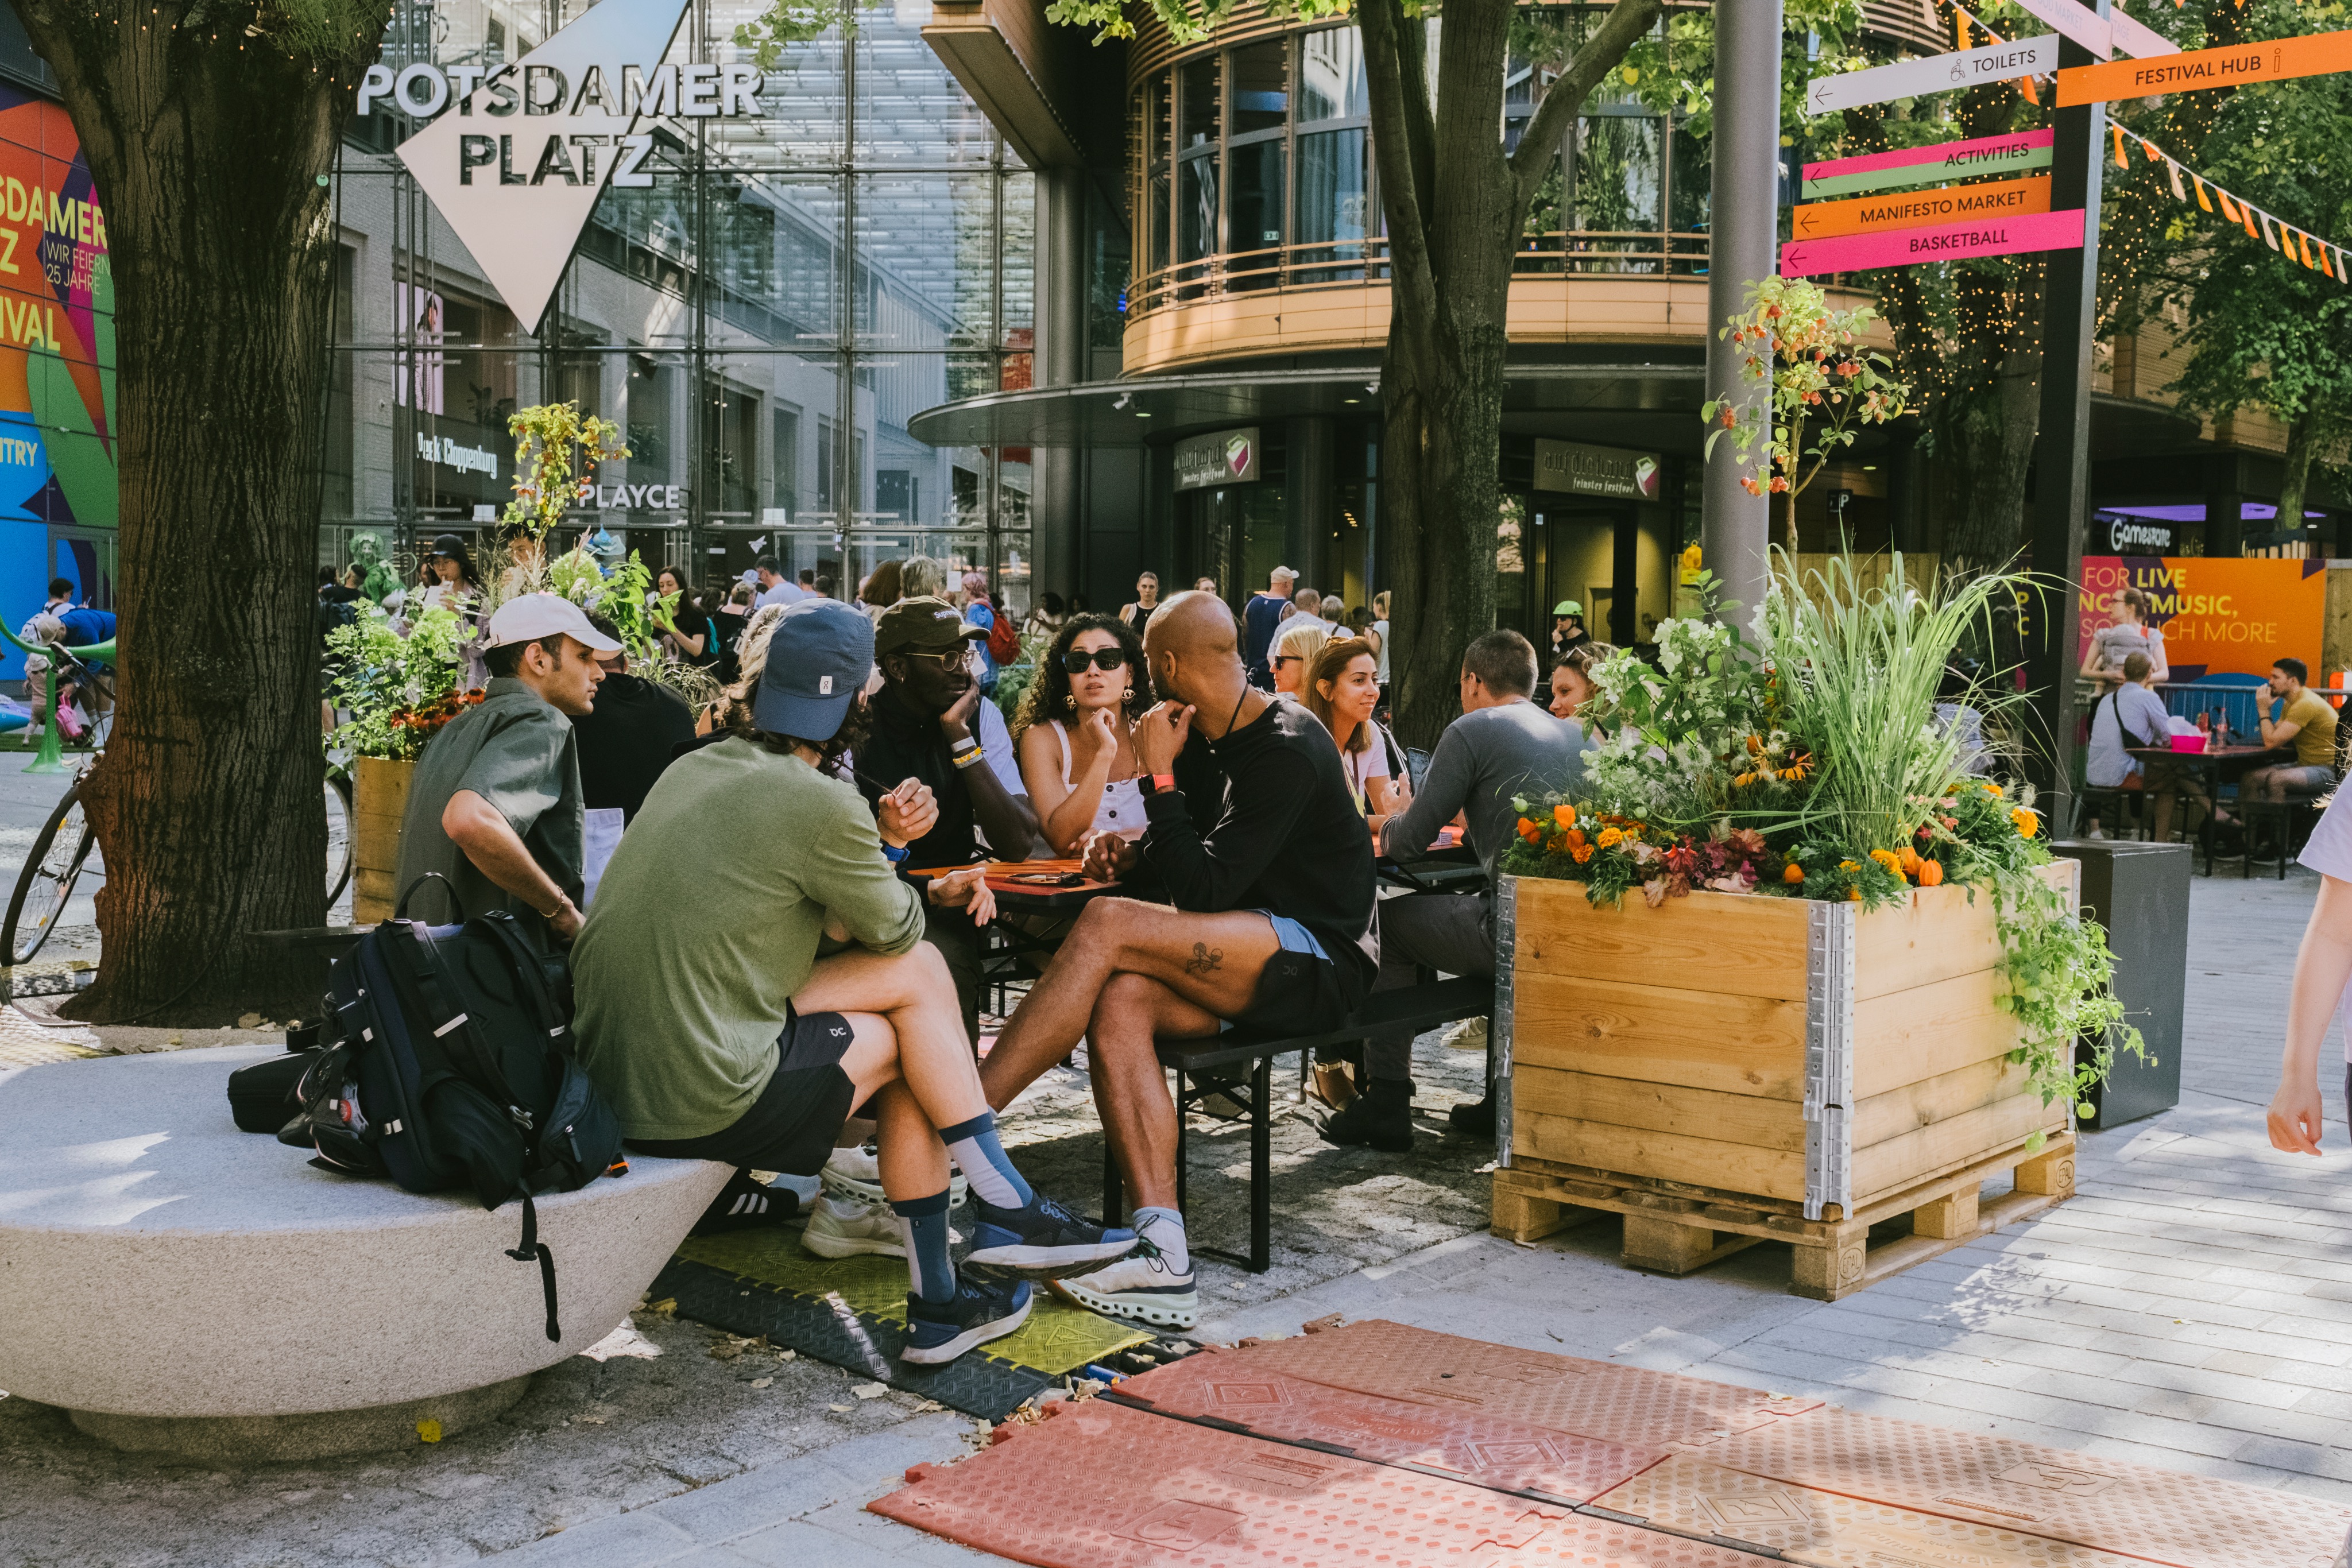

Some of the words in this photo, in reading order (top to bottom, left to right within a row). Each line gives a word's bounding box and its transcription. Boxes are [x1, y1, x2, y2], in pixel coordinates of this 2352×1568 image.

[1973, 49, 2036, 73] TOILETS
[2136, 63, 2215, 86] FESTIVAL
[2221, 56, 2261, 75] HUB
[357, 63, 765, 117] POTSDAMER
[459, 134, 653, 187] PLATZ
[1945, 143, 2029, 167] ACTIVITIES
[1860, 200, 1952, 224] MANIFESTO
[1958, 191, 2026, 212] MARKET
[1909, 230, 2009, 253] BASKETBALL
[46, 239, 69, 265] WIR
[73, 247, 111, 276] FEIERN
[47, 264, 61, 284] 25
[64, 268, 100, 295] JAHRE
[579, 484, 680, 509] PLAYCE
[2084, 567, 2130, 588] FOR
[2137, 568, 2187, 588] LIVE
[2151, 595, 2238, 618] MUSIC,
[2204, 622, 2278, 644] MORE
[1843, 1253, 1860, 1274] EPAL
